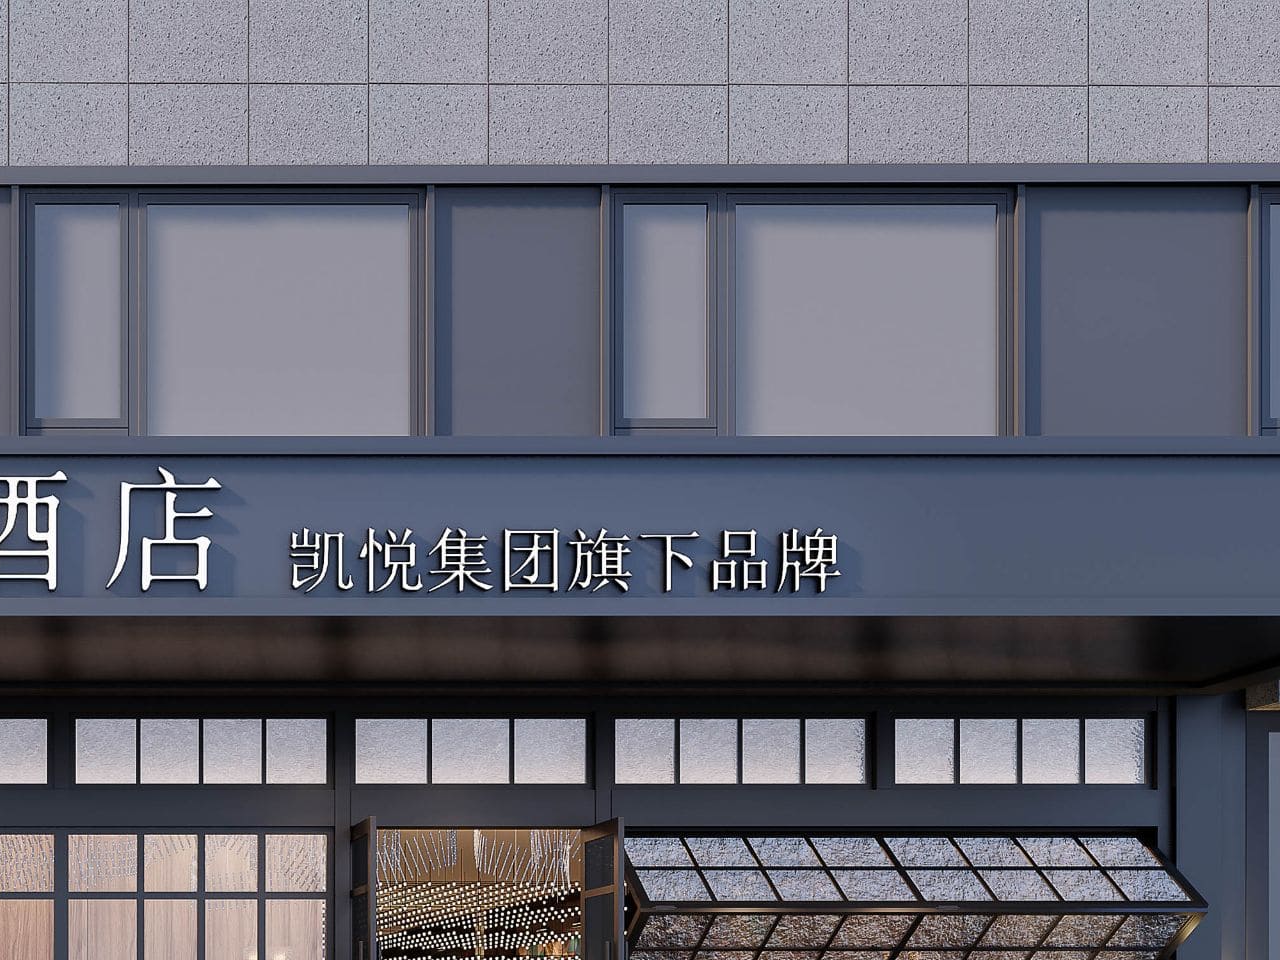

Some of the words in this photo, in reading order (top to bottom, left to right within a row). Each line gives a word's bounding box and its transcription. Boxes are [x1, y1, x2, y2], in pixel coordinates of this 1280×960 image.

[289, 527, 842, 593] 凯悦集团旗下品牌
